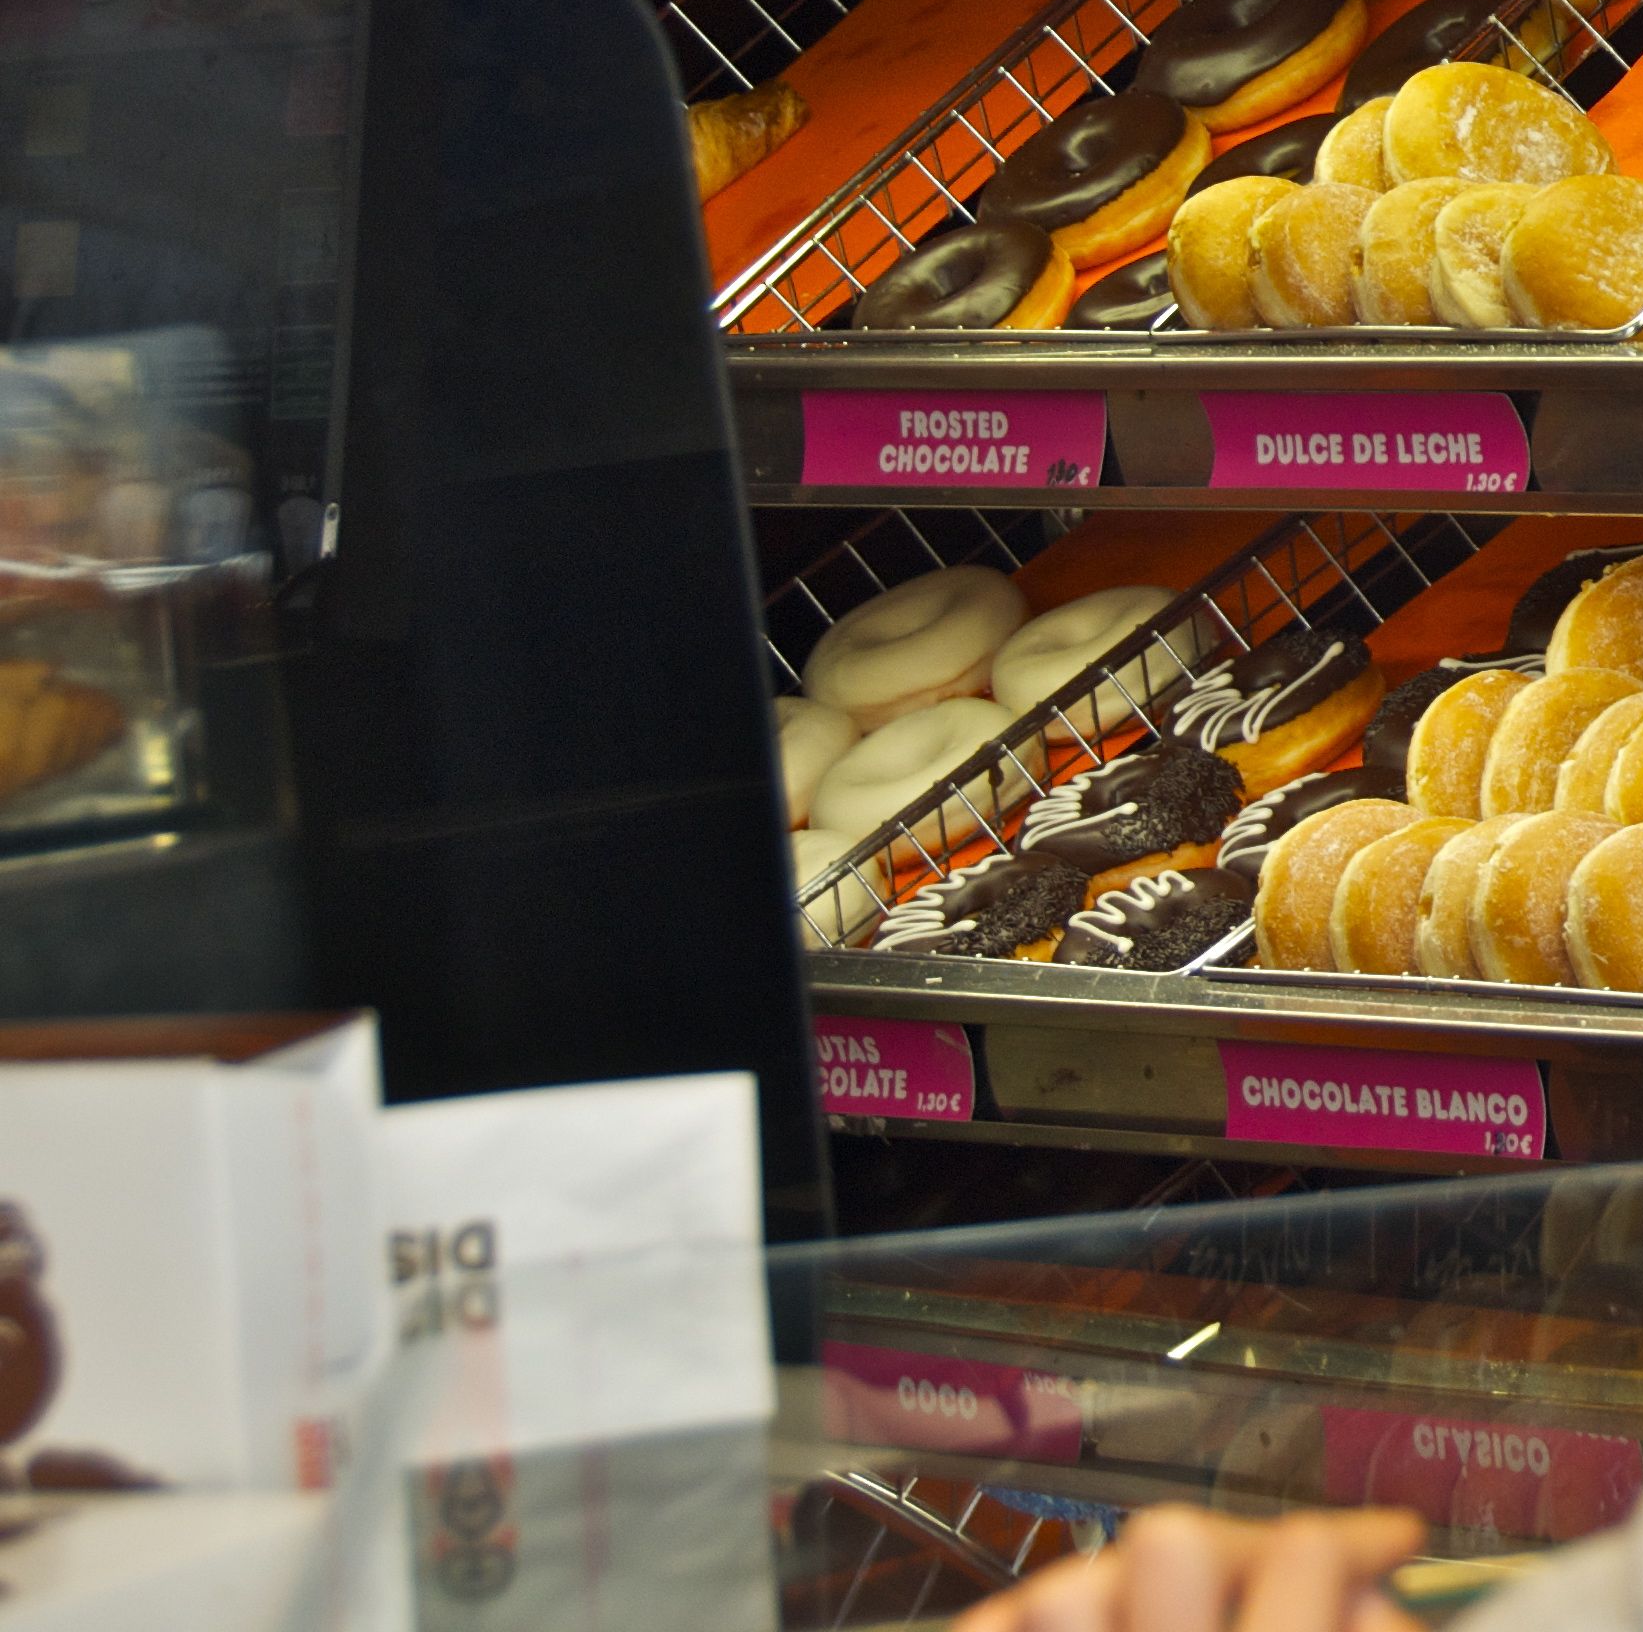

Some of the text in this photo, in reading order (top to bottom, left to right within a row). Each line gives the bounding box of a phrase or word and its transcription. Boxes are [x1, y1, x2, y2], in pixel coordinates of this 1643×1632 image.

[900, 410, 1008, 439] FROSTED
[879, 444, 1030, 473] CHOCOLATE
[1256, 432, 1483, 465] DULCE DE LECHE
[816, 1035, 881, 1065] UTAS
[1242, 1075, 1528, 1127] CHOCOLATE BLANCO
